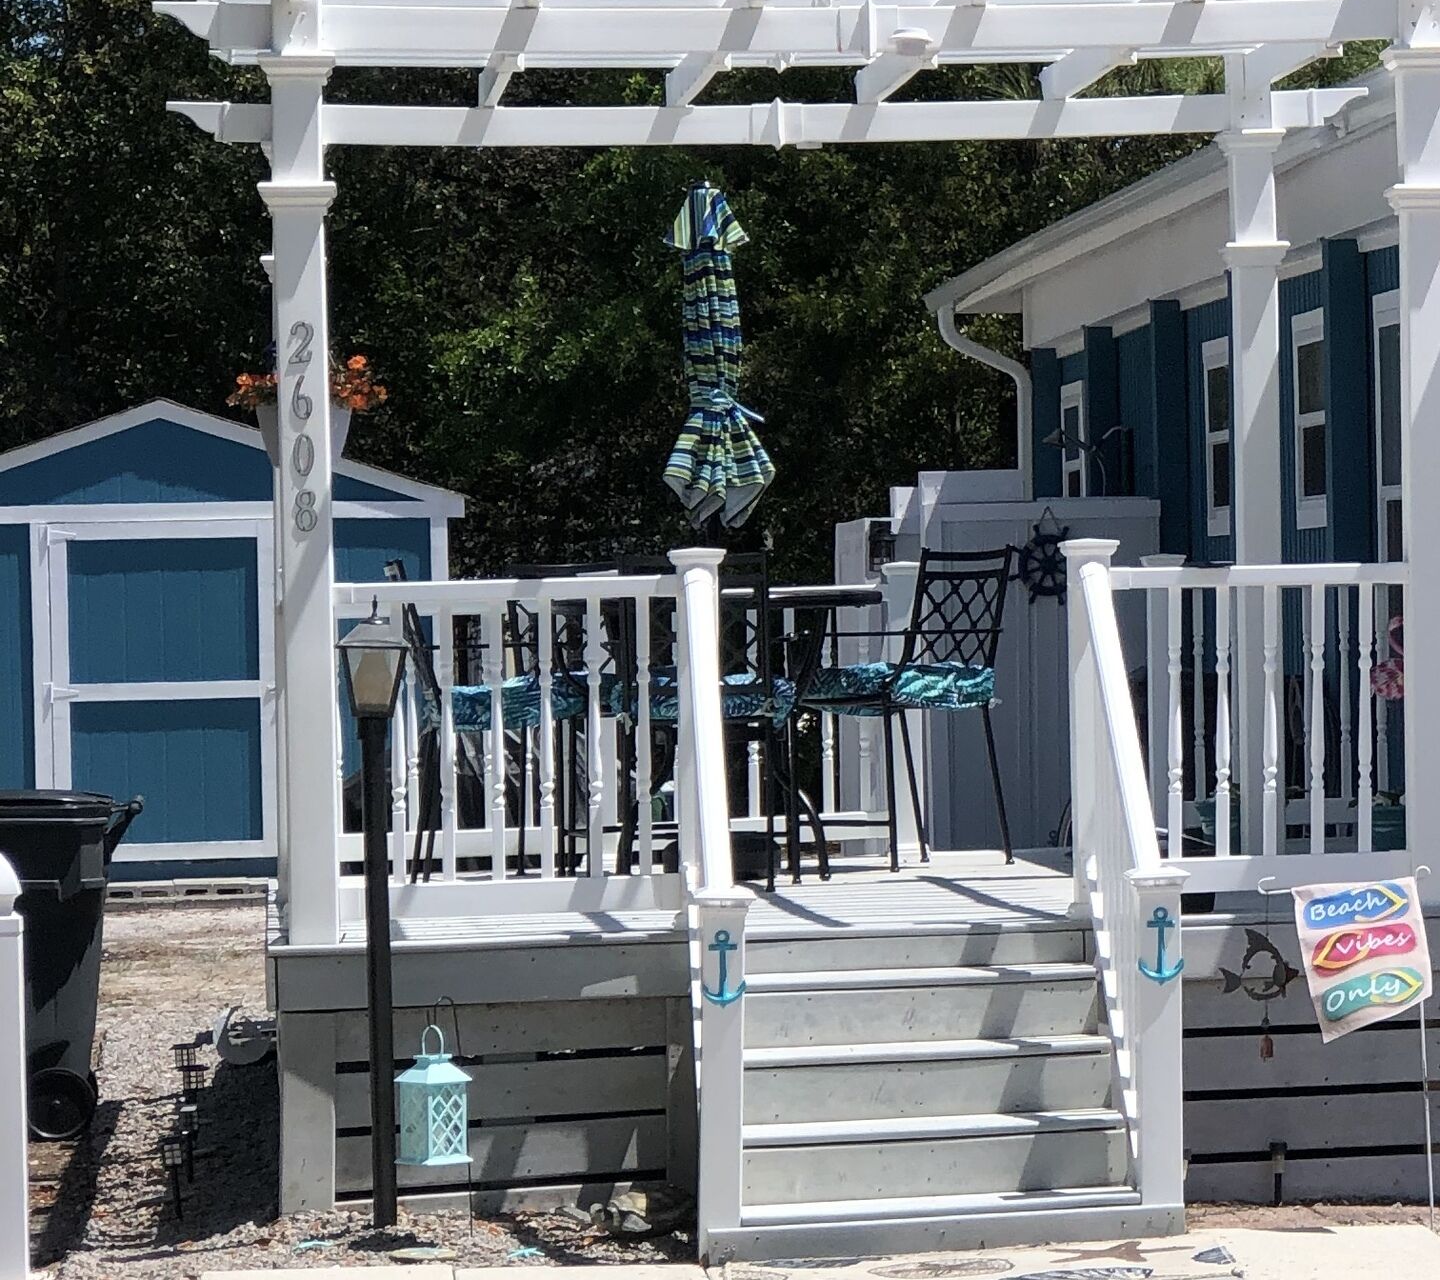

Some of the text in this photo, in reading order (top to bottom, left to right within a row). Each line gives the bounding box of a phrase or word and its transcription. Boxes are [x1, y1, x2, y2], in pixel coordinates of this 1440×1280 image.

[288, 321, 317, 532] 2608
[1310, 892, 1388, 921] Beach
[1336, 931, 1411, 954] Vibes
[1326, 976, 1400, 1012] Only
